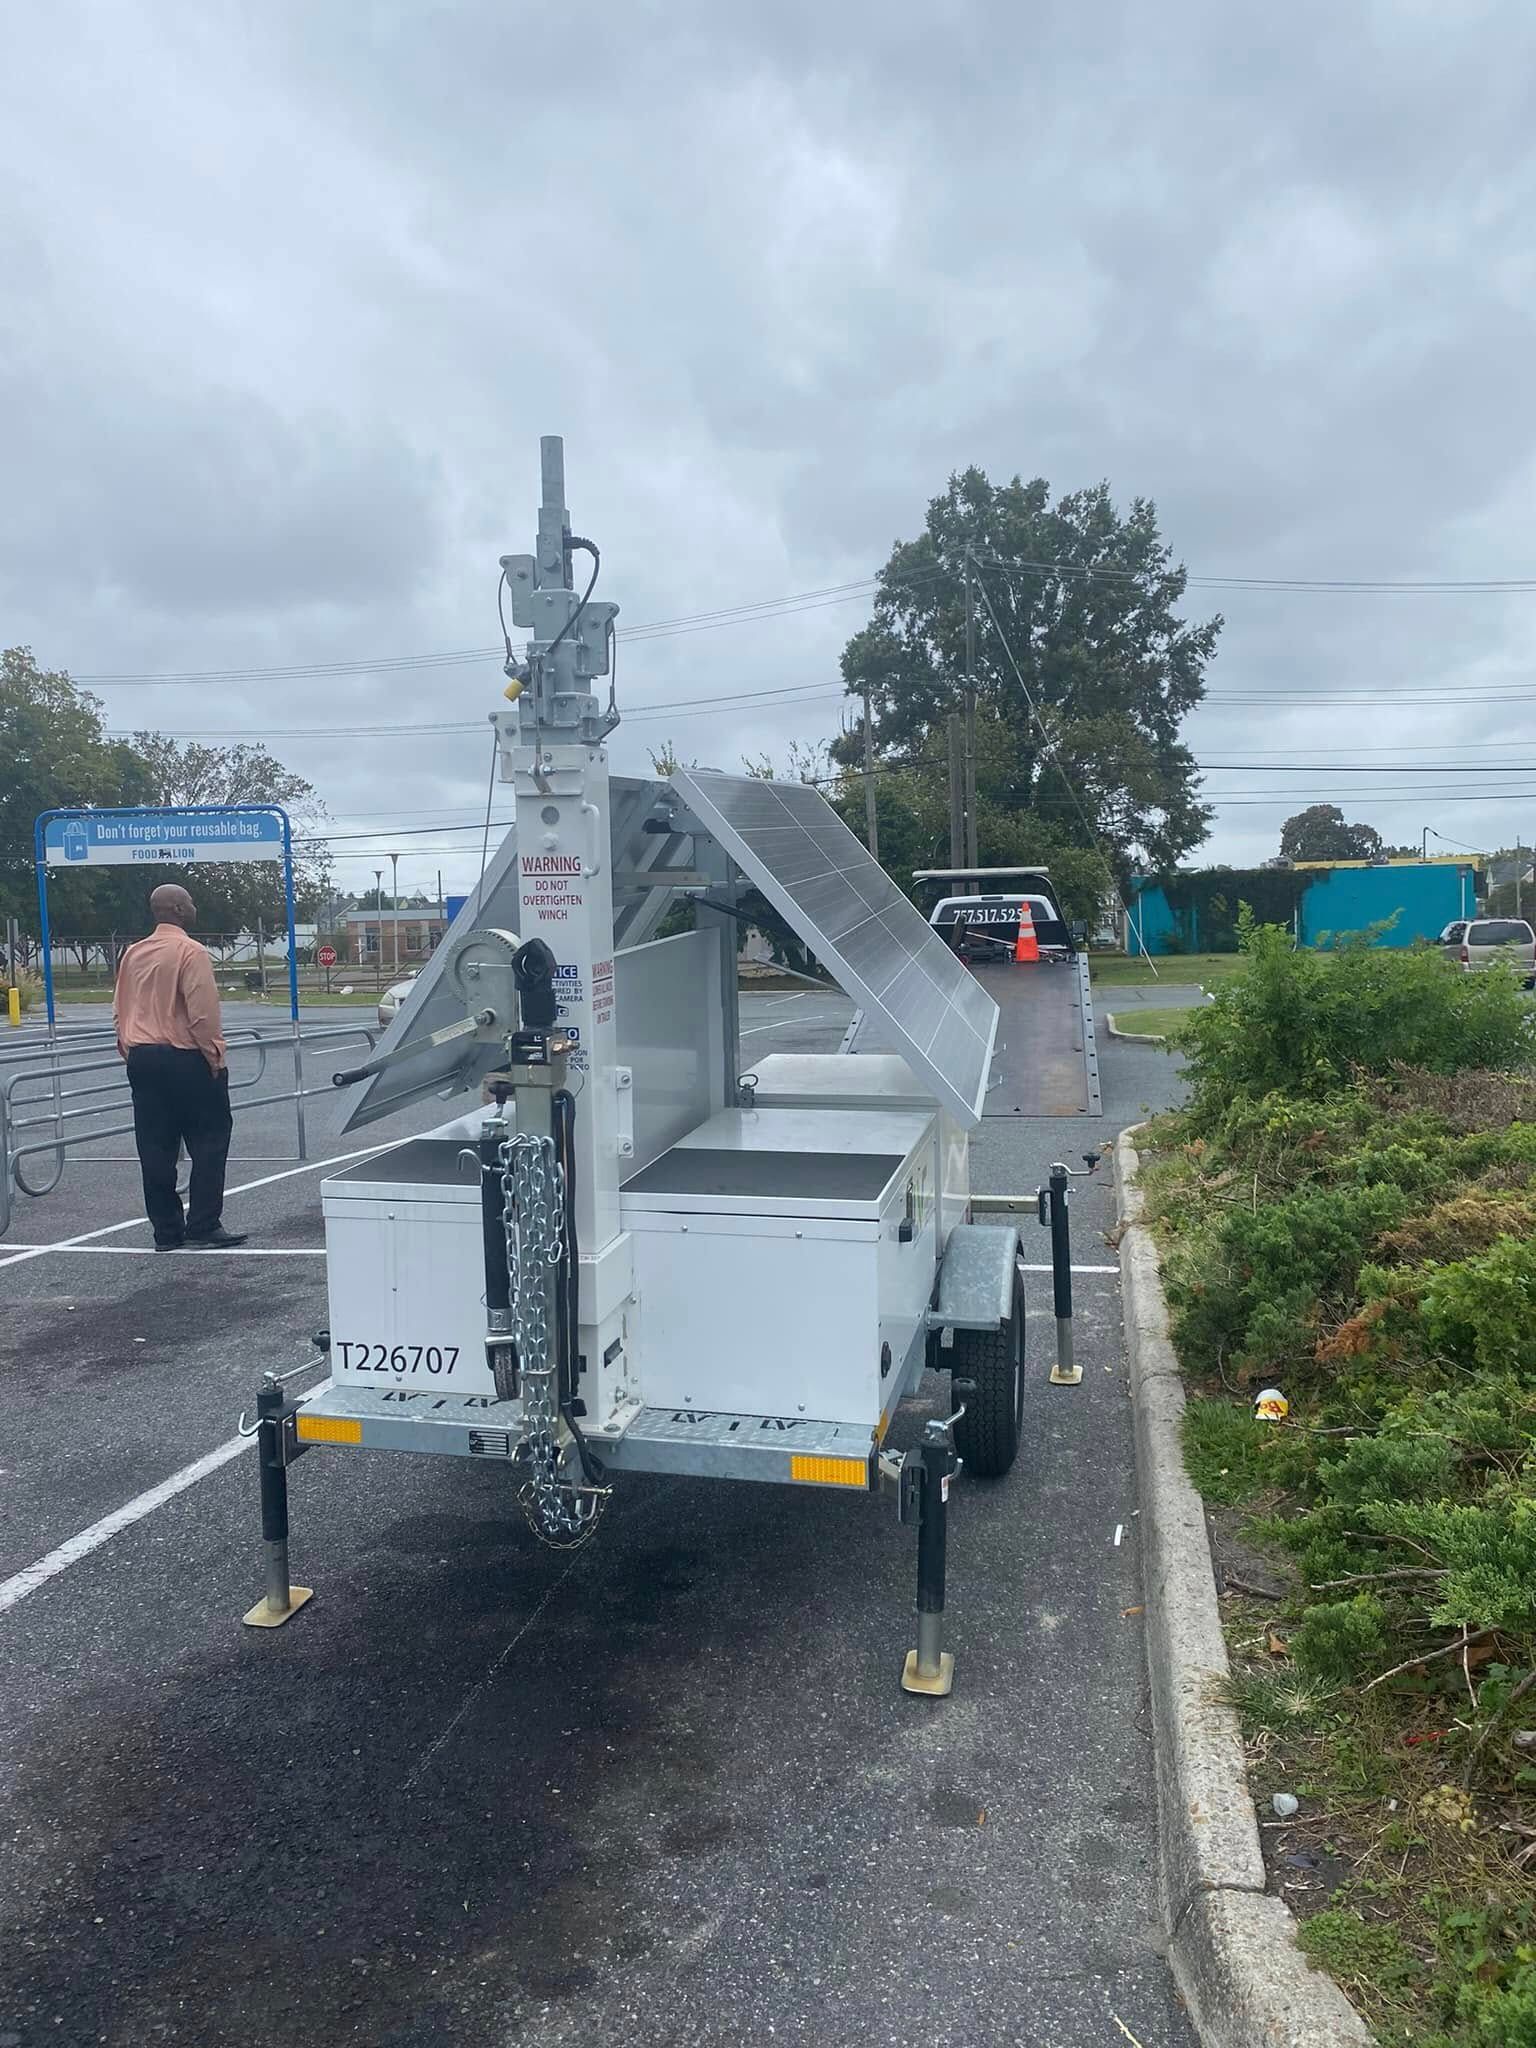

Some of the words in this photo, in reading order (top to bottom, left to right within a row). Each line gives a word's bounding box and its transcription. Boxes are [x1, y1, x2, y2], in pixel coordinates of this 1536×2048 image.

[97, 824, 126, 839] Don't
[129, 823, 161, 841] forget
[164, 826, 188, 841] your
[191, 822, 237, 836] reusable
[240, 821, 263, 838] bag.
[132, 849, 157, 859] FOOD
[173, 848, 195, 858] LION
[522, 856, 581, 872] WARNING
[535, 880, 549, 890] DO
[550, 880, 568, 890] NOT
[523, 895, 582, 905] OVERTIGHTEN
[538, 910, 567, 920] WINCH
[954, 908, 1031, 922] 757.517.525
[320, 952, 336, 961] STOP
[337, 1342, 460, 1374] T226707
